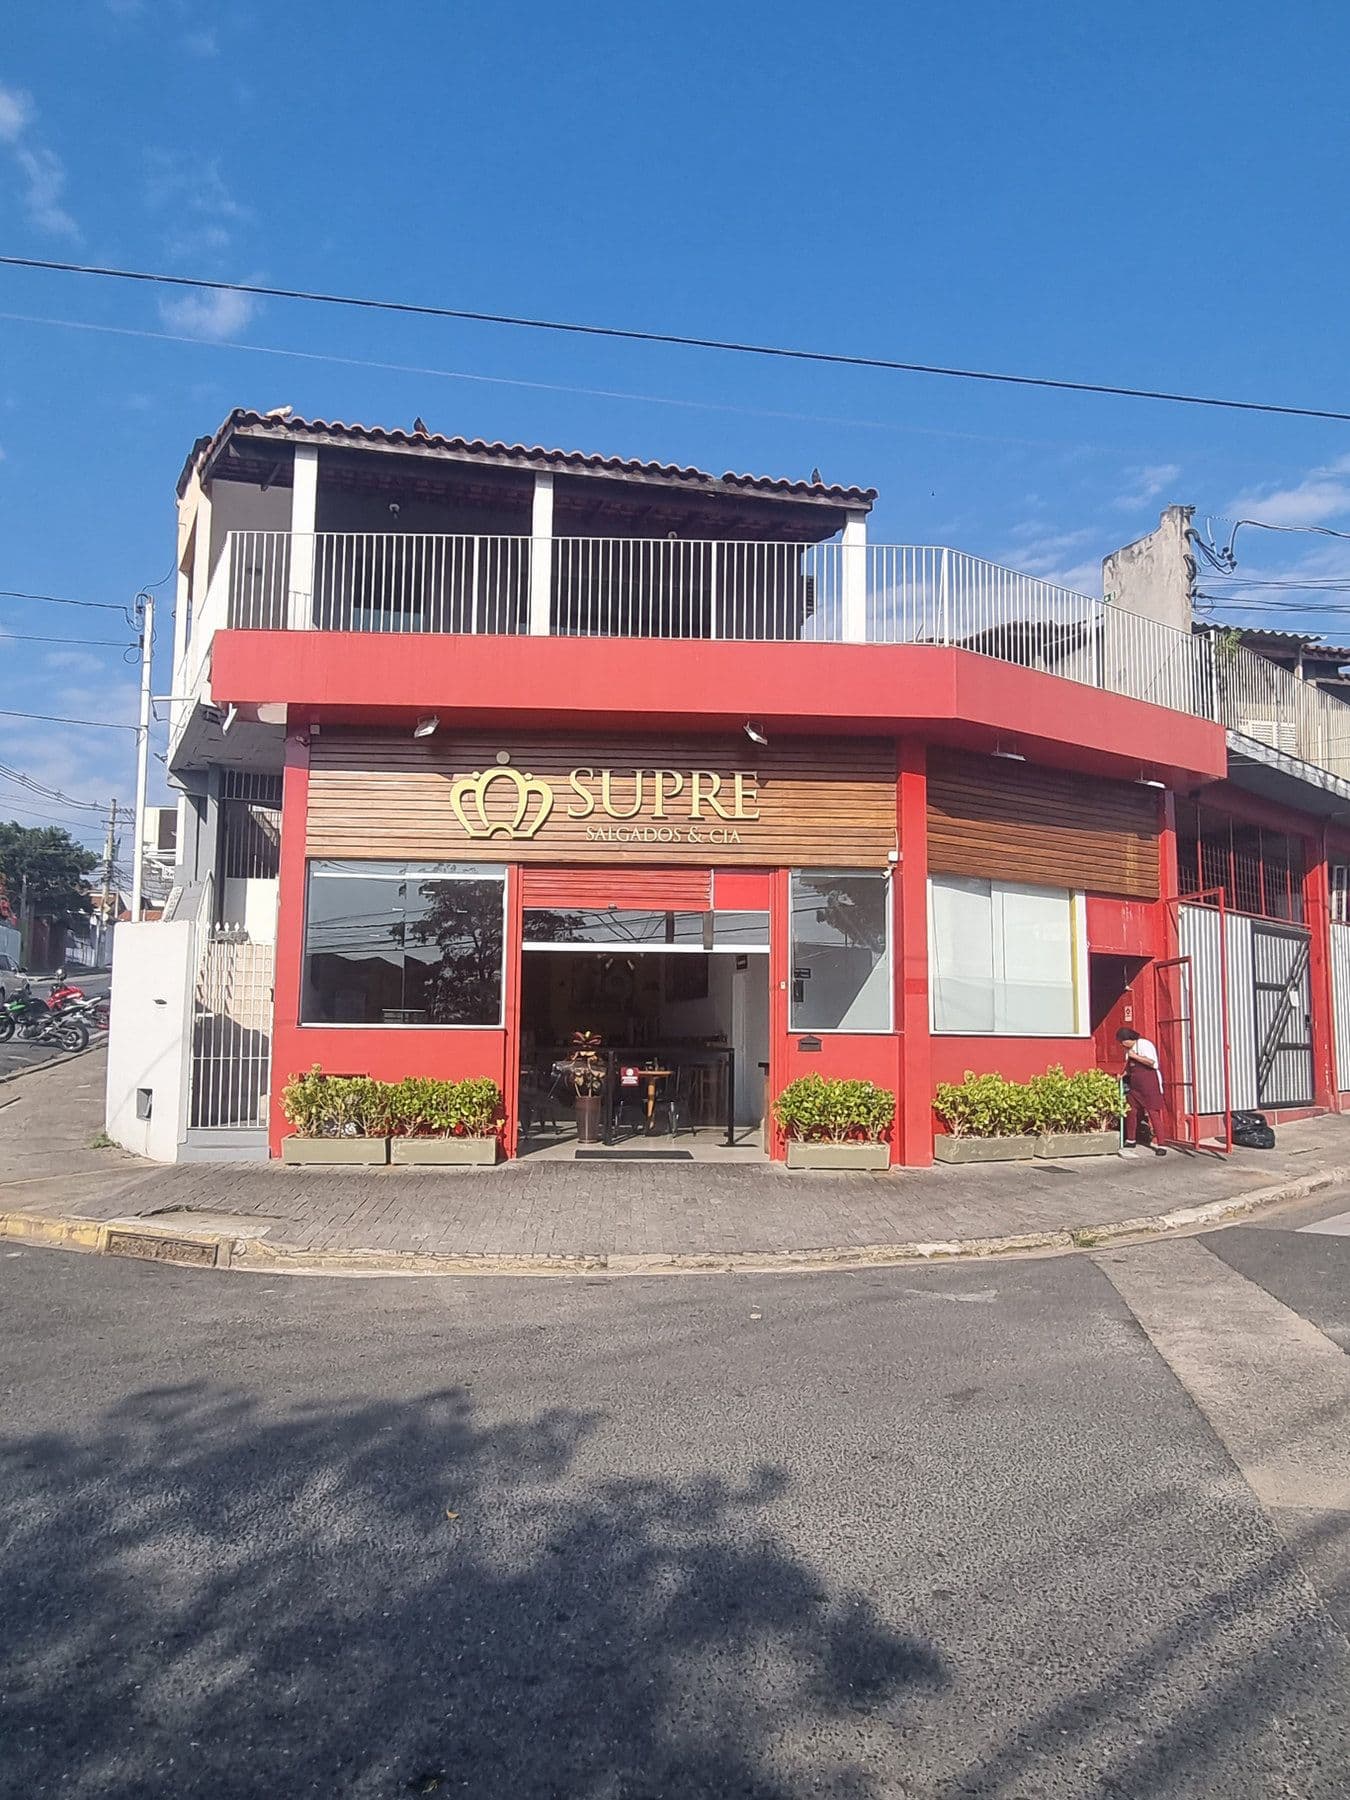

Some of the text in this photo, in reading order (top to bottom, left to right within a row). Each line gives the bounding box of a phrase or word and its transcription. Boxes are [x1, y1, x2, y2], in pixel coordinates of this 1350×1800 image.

[567, 767, 760, 820] SUPRE
[586, 825, 741, 844] SALGADOS & CIA
